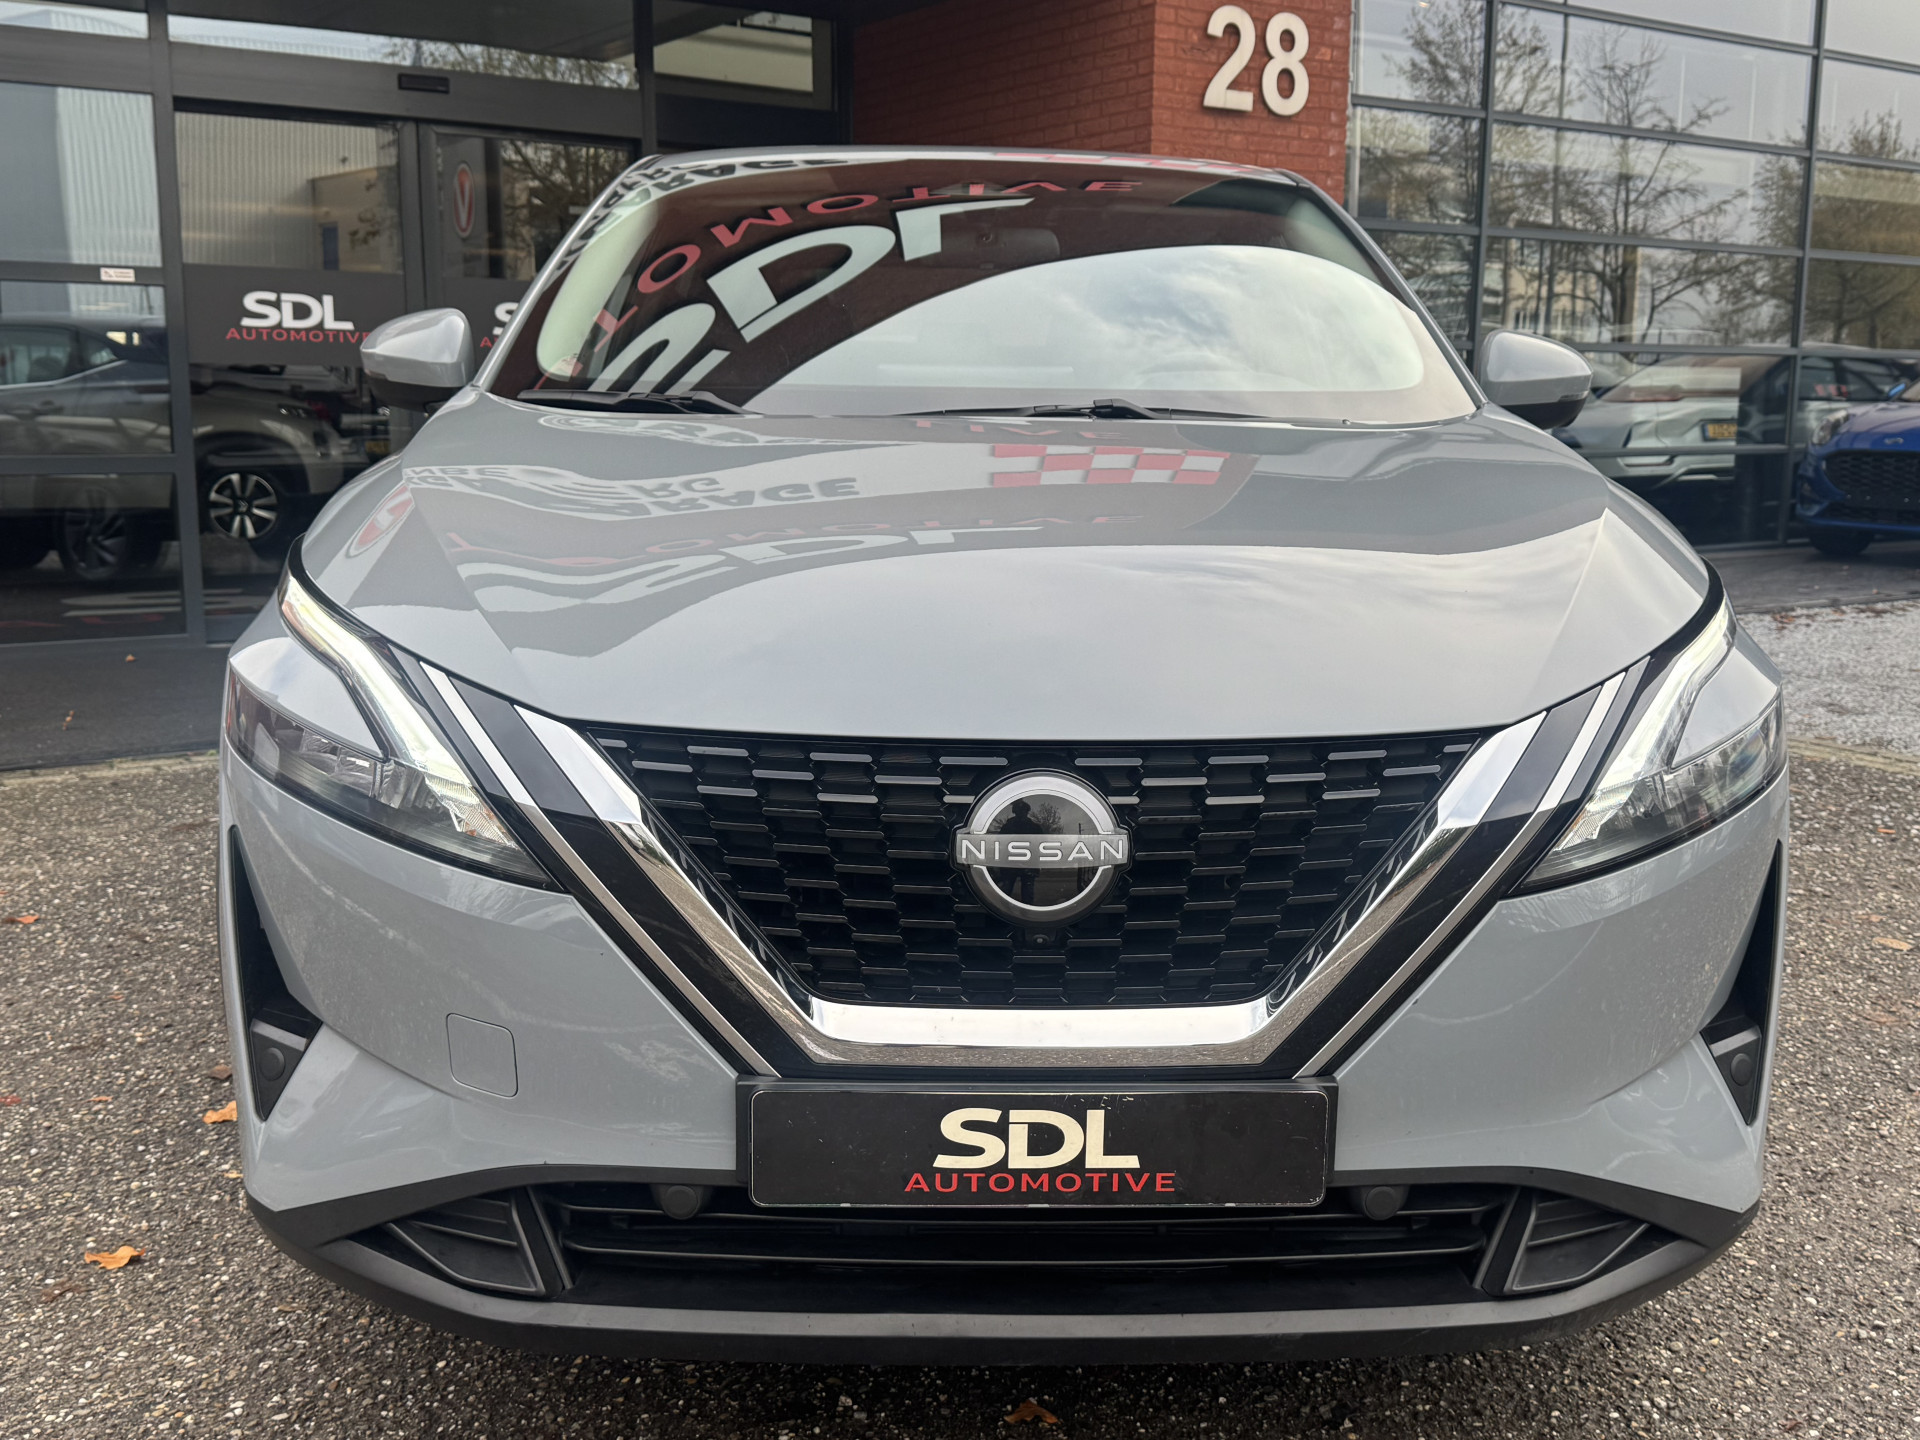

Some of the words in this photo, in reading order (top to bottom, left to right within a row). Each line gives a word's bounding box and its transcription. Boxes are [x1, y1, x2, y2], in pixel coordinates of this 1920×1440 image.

[1203, 5, 1309, 116] 28
[240, 291, 355, 330] SDL
[961, 839, 1123, 861] NISSAN
[933, 1107, 1140, 1169] SDL
[904, 1173, 1176, 1192] AUTOMOTIVE
